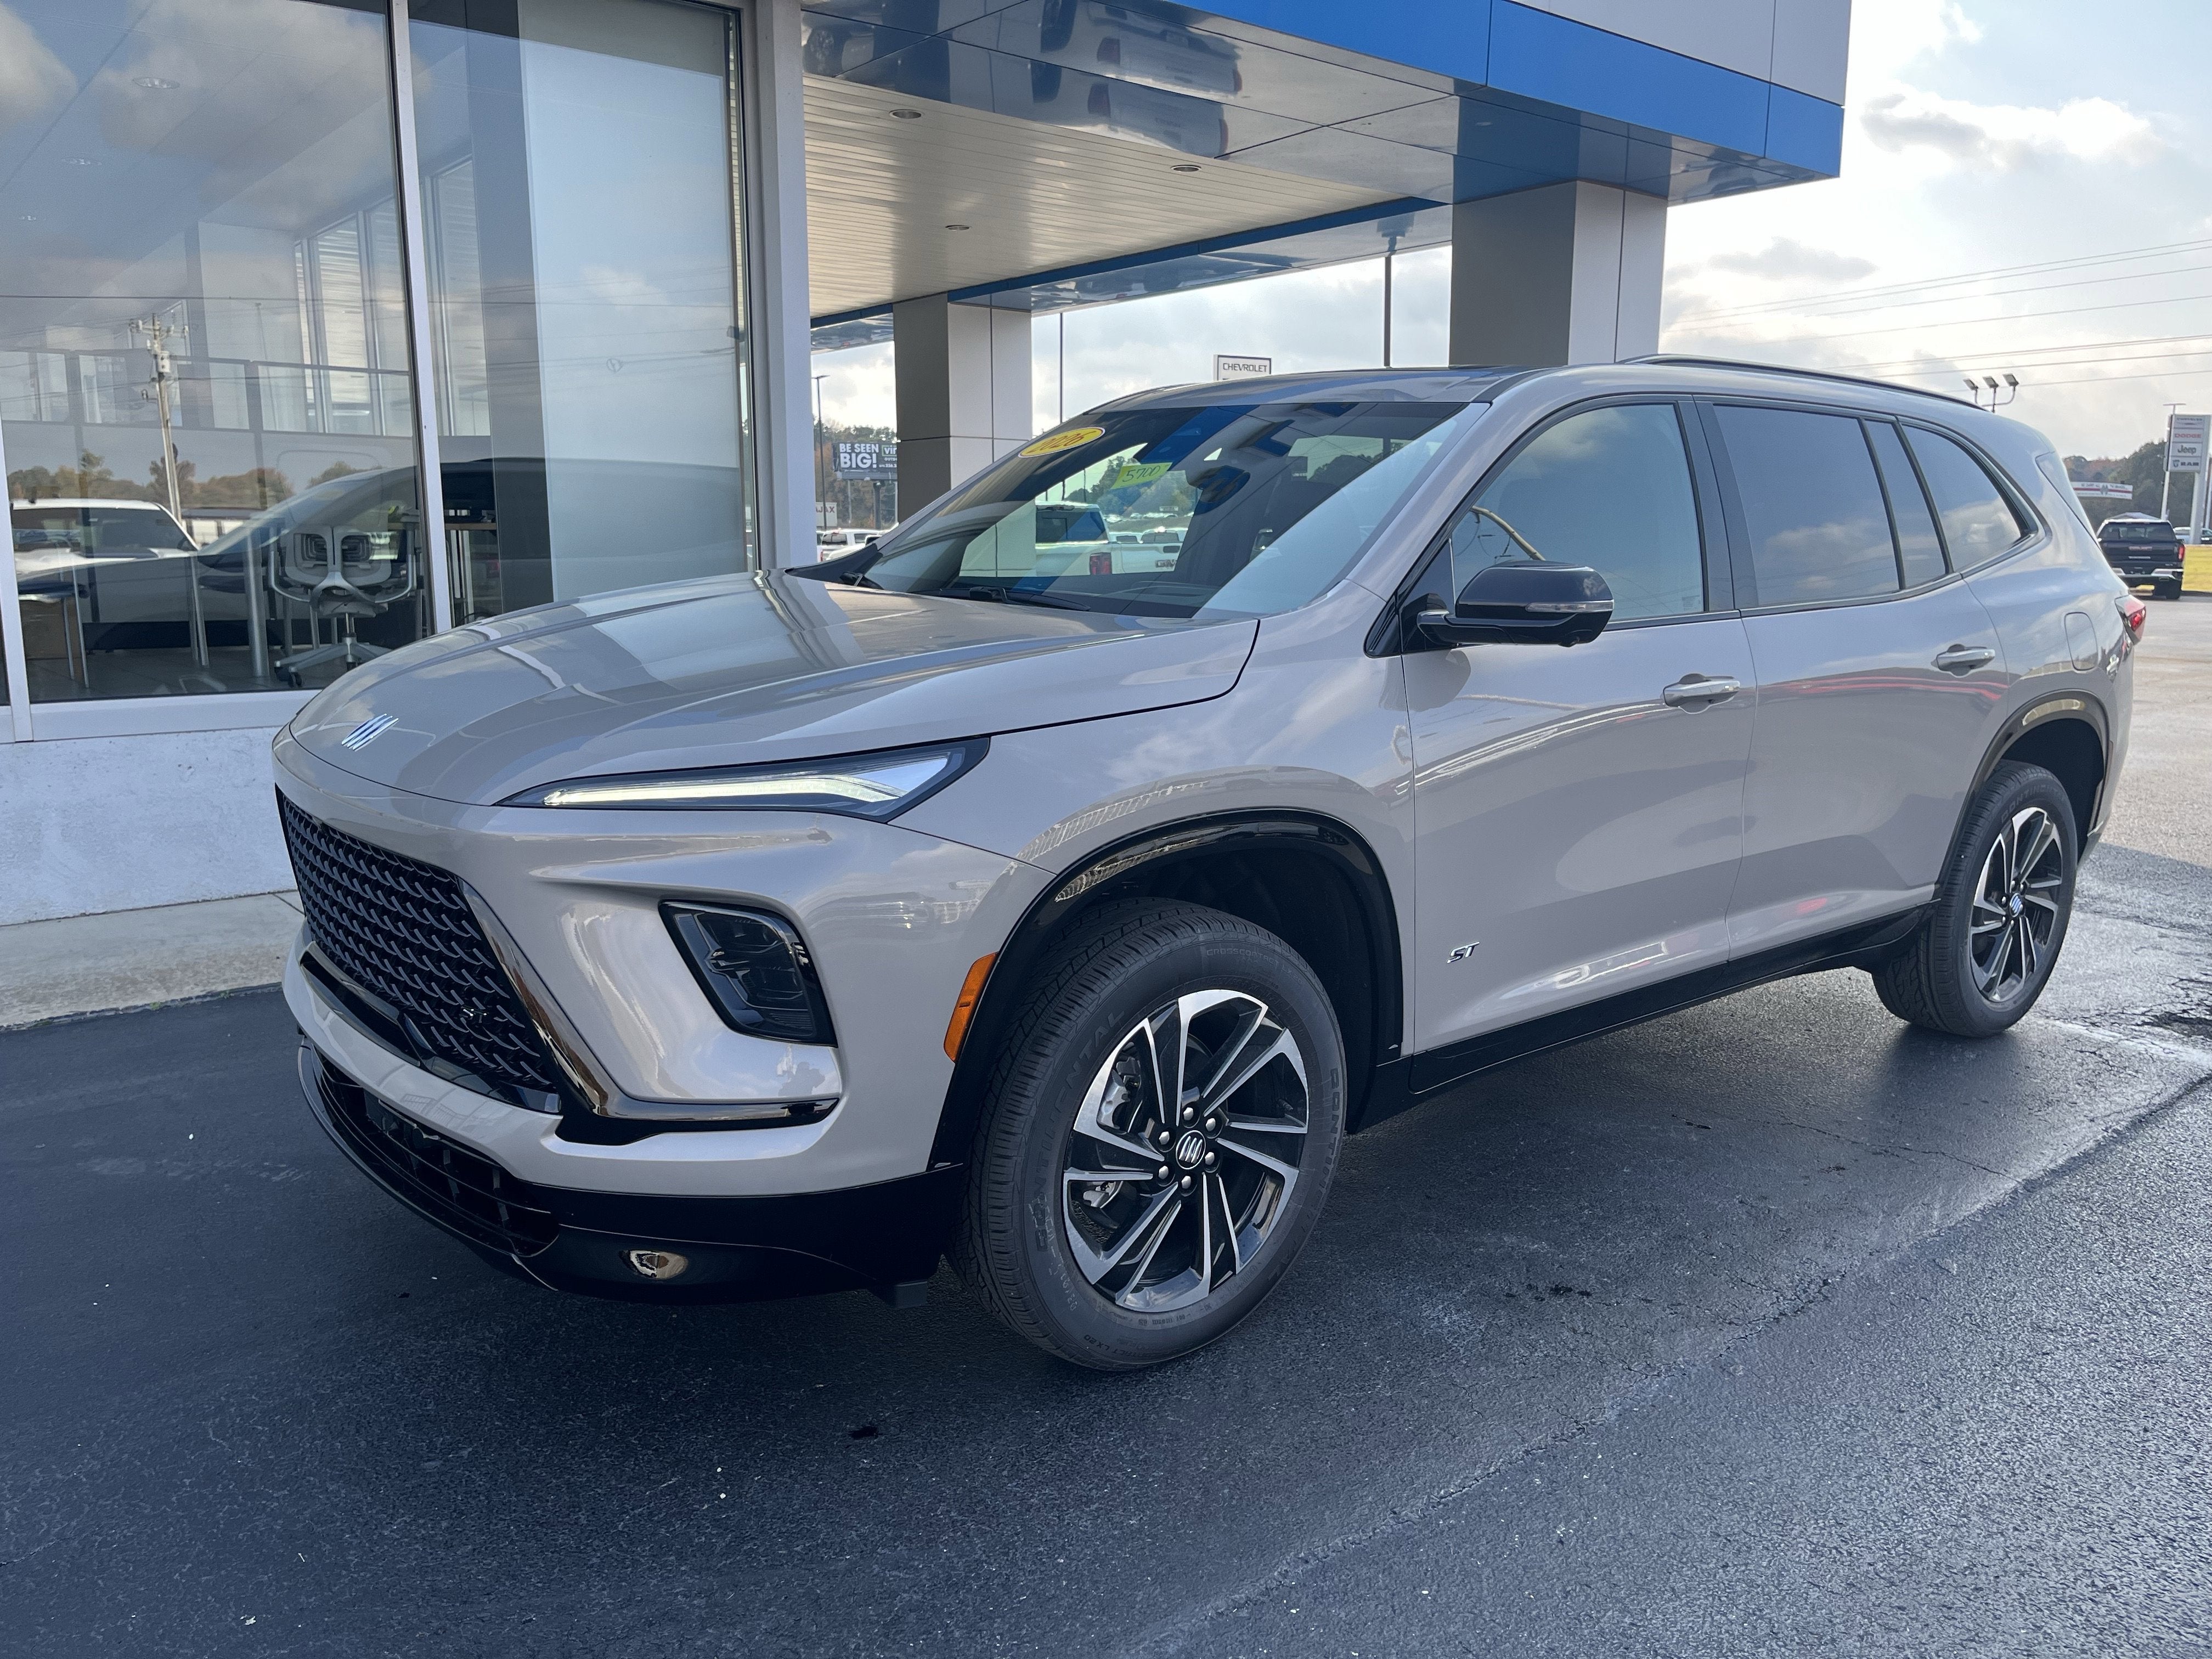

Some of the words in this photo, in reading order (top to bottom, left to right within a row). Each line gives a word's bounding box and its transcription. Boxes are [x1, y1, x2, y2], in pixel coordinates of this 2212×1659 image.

[1223, 363, 1267, 373] CHEVROLET
[840, 443, 851, 452] BE
[854, 443, 879, 453] SEEN
[2177, 445, 2196, 455] Jeep
[840, 453, 877, 468] BIG!
[1122, 465, 1160, 483] 5700
[1206, 948, 1279, 966] CROSSCONTACT
[1447, 941, 1480, 963] ST
